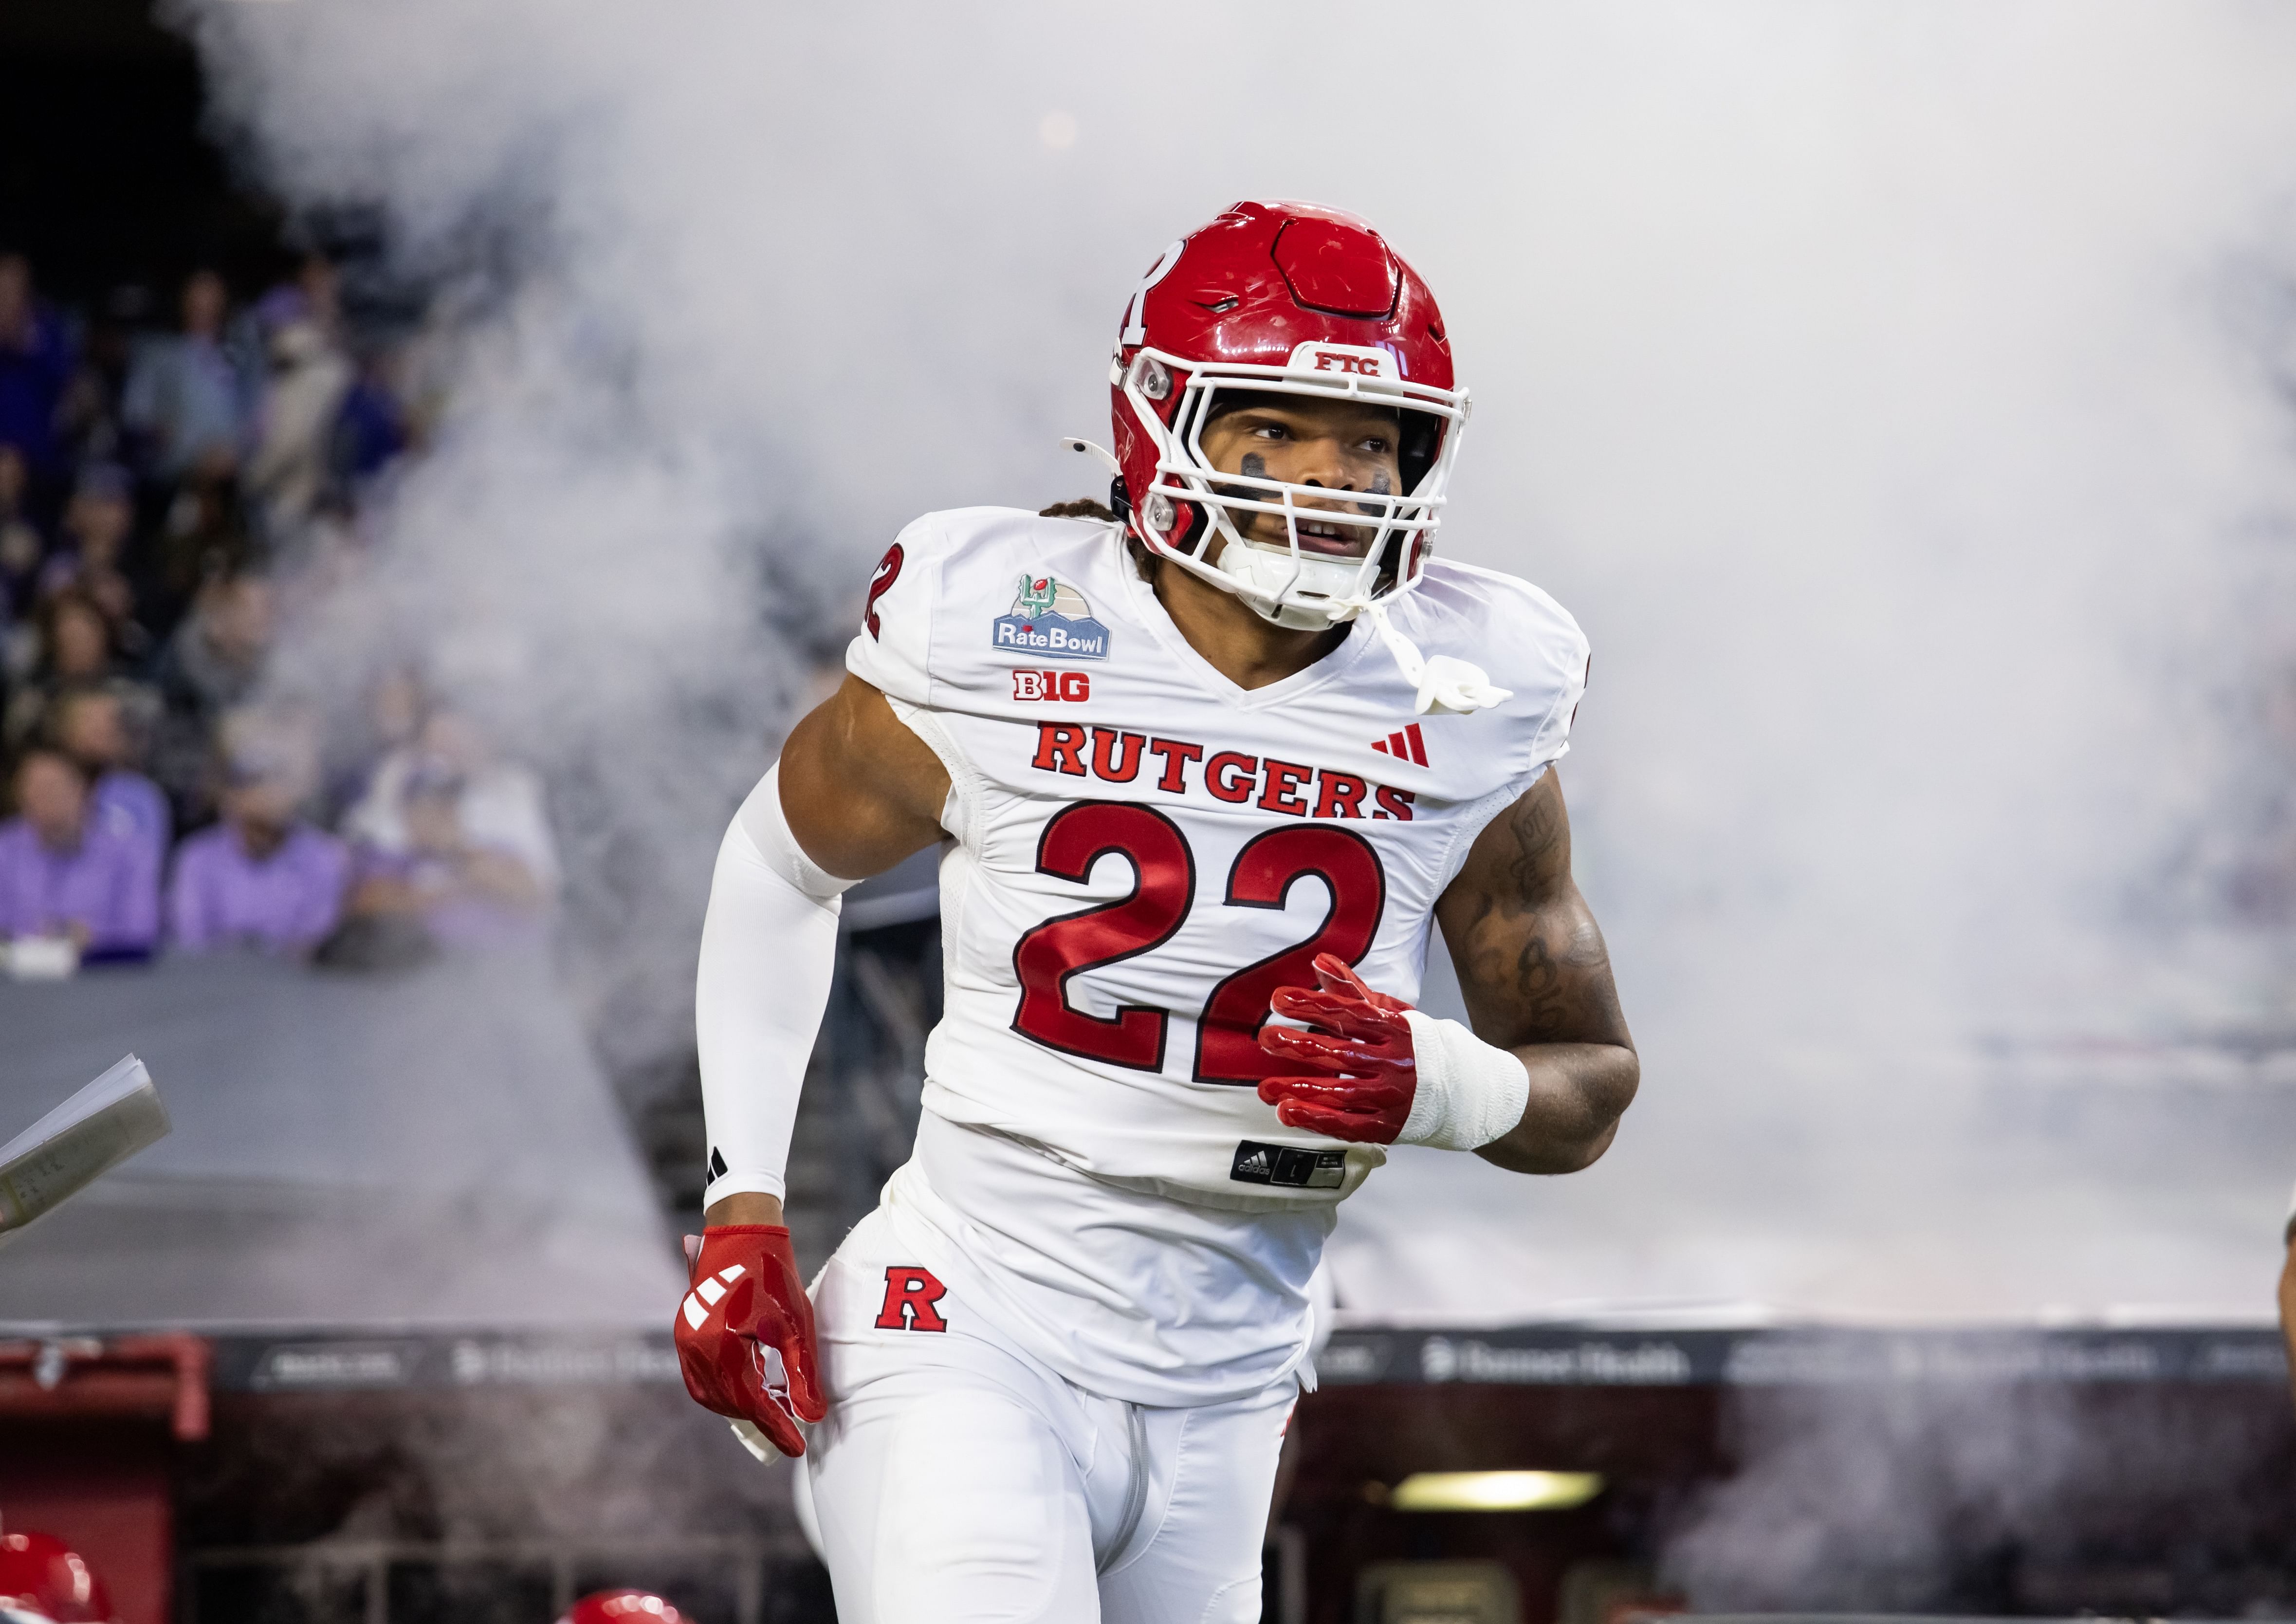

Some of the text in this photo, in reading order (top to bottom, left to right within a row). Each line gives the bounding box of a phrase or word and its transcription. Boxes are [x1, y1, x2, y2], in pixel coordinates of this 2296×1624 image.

[1315, 351, 1381, 377] FTC
[1032, 720, 1415, 821] RUTGERS
[1010, 799, 1386, 1086] 22
[1238, 1164, 1270, 1175] adidas
[874, 1266, 948, 1332] R
